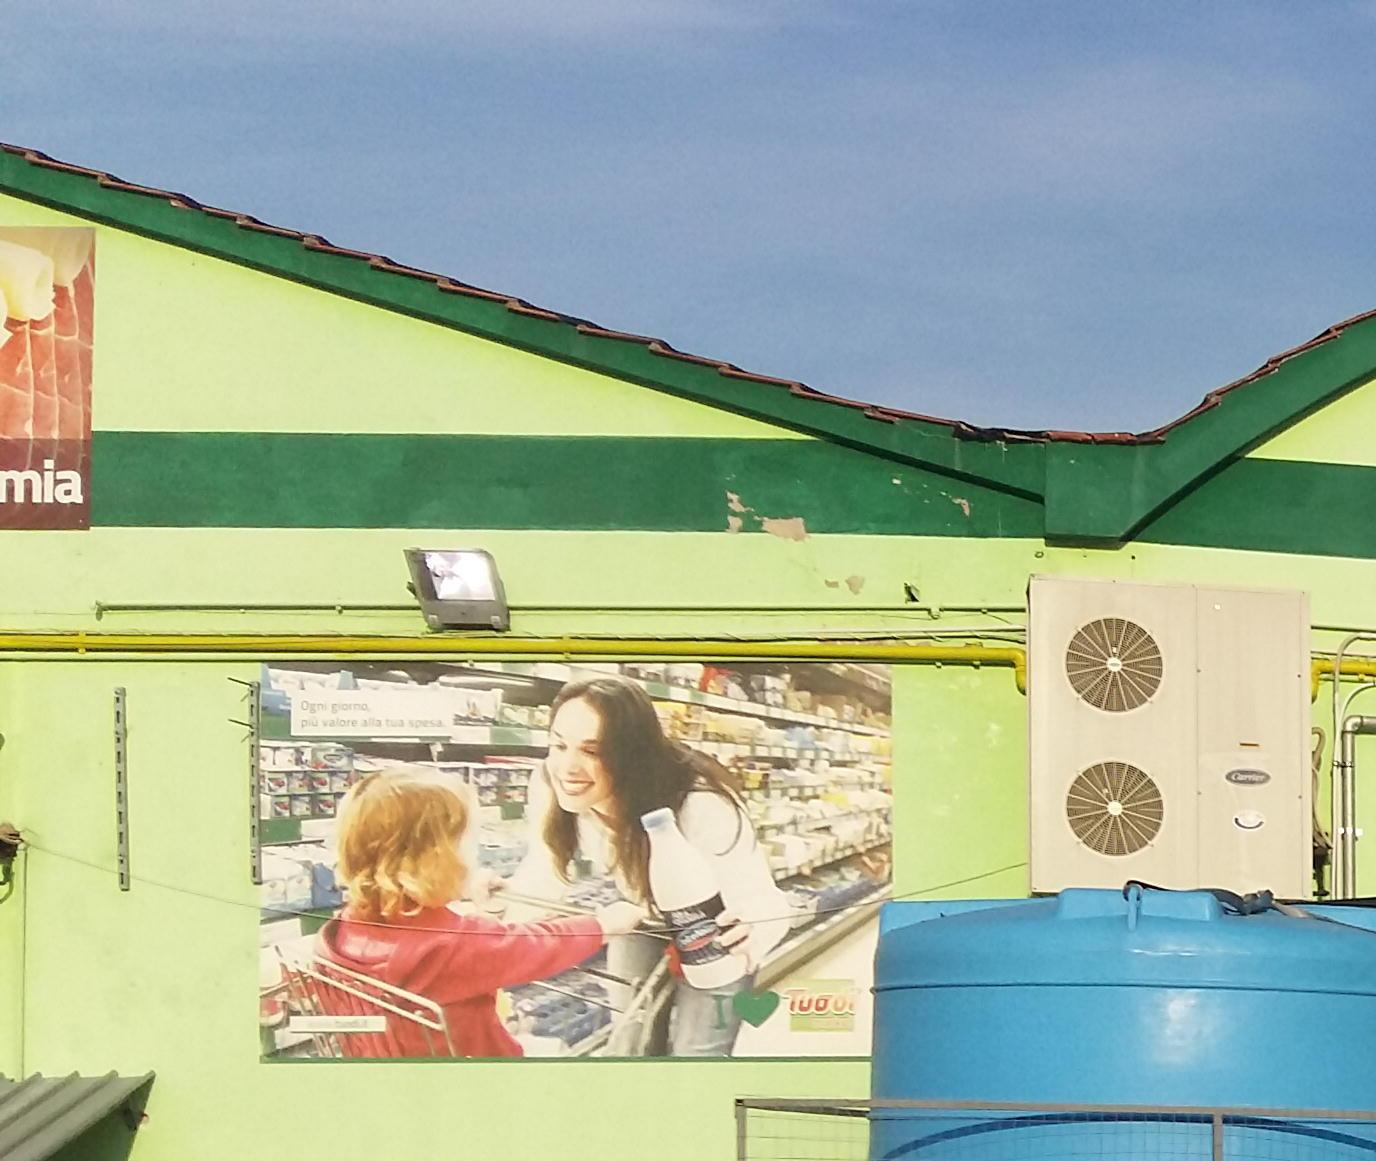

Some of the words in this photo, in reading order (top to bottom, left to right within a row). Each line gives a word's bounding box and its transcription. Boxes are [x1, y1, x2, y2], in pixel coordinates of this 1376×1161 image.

[0, 458, 84, 504] mia
[301, 700, 327, 713] Ogni
[331, 702, 371, 714] giorno,
[301, 716, 318, 728] più
[322, 717, 357, 727] valore
[362, 718, 382, 728] alla
[386, 718, 404, 728] tua
[408, 719, 446, 729] spesa.
